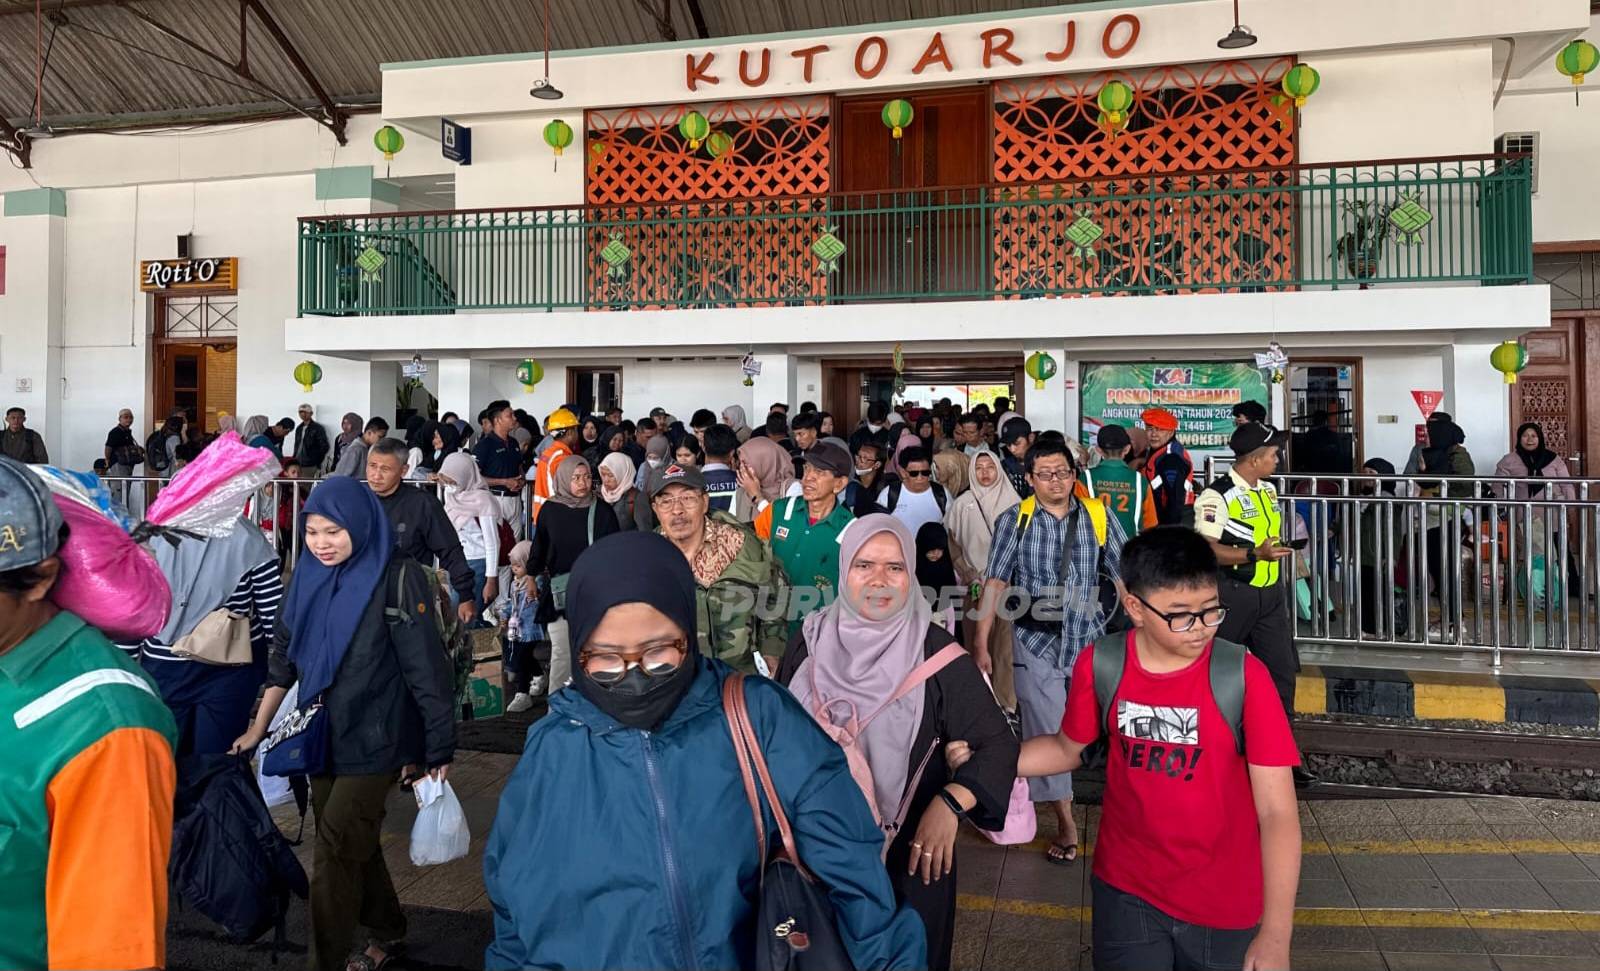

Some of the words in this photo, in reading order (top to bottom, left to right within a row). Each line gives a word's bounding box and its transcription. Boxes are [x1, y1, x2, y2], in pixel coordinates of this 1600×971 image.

[686, 13, 1141, 92] KUTOARJO
[1153, 368, 1193, 385] KAI
[1106, 388, 1150, 404] POSKO
[1151, 388, 1241, 404] PENGAMANAN
[1185, 408, 1212, 419] TAHUN
[1215, 408, 1234, 419] 202
[1184, 421, 1205, 431] 1446
[1206, 421, 1213, 431] H
[1176, 433, 1231, 446] WOKERT
